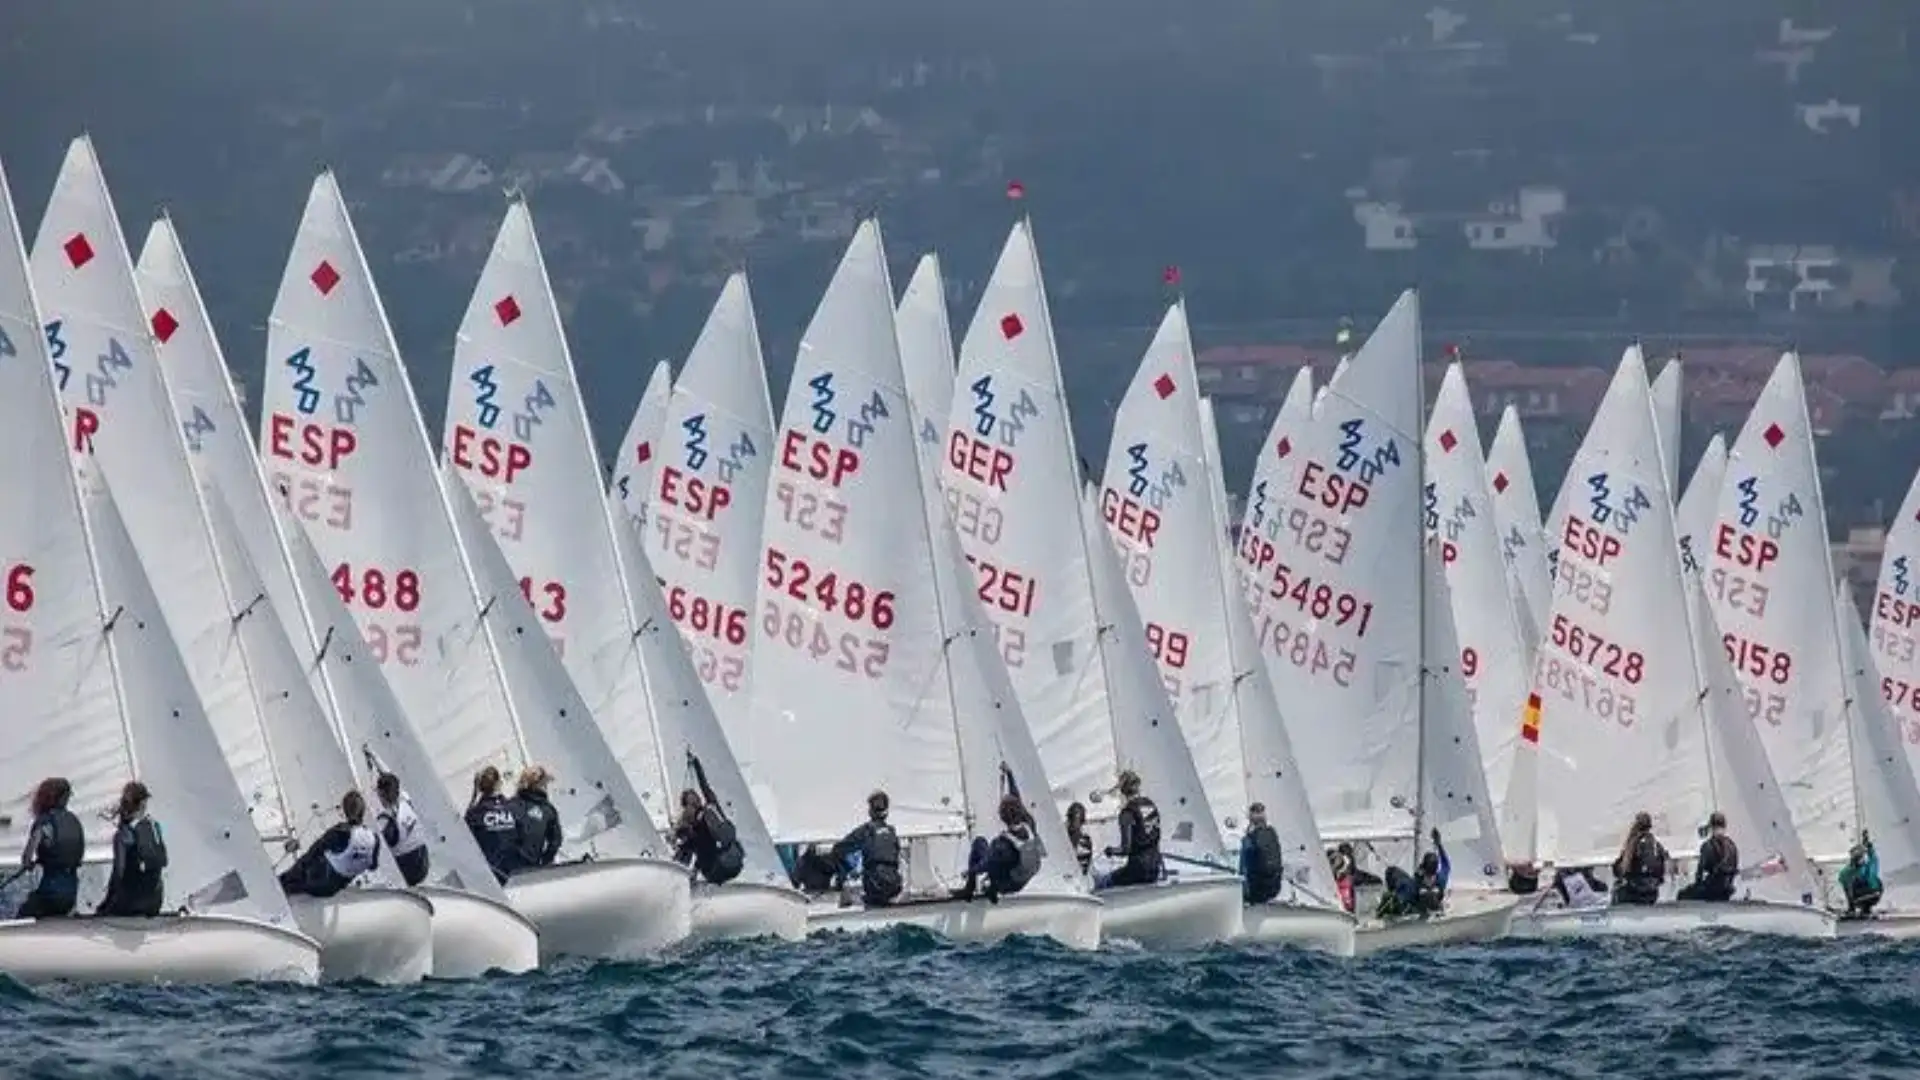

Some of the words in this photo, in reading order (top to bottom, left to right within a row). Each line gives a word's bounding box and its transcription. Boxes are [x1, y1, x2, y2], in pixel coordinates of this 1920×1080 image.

[271, 413, 356, 470] ESP
[454, 424, 531, 484] ESP
[782, 429, 859, 487] ESP
[949, 430, 1013, 492] GER
[660, 465, 731, 521] ESP
[1299, 460, 1369, 515] ESP
[1101, 487, 1161, 549] GER
[1564, 514, 1621, 566] ESP
[1716, 523, 1779, 572] ESP
[656, 576, 747, 645] 6816
[767, 548, 895, 629] 52486
[966, 555, 1035, 617] 251
[1270, 564, 1373, 637] 54891
[1877, 591, 1920, 629] ESP
[1552, 613, 1643, 685] 56728
